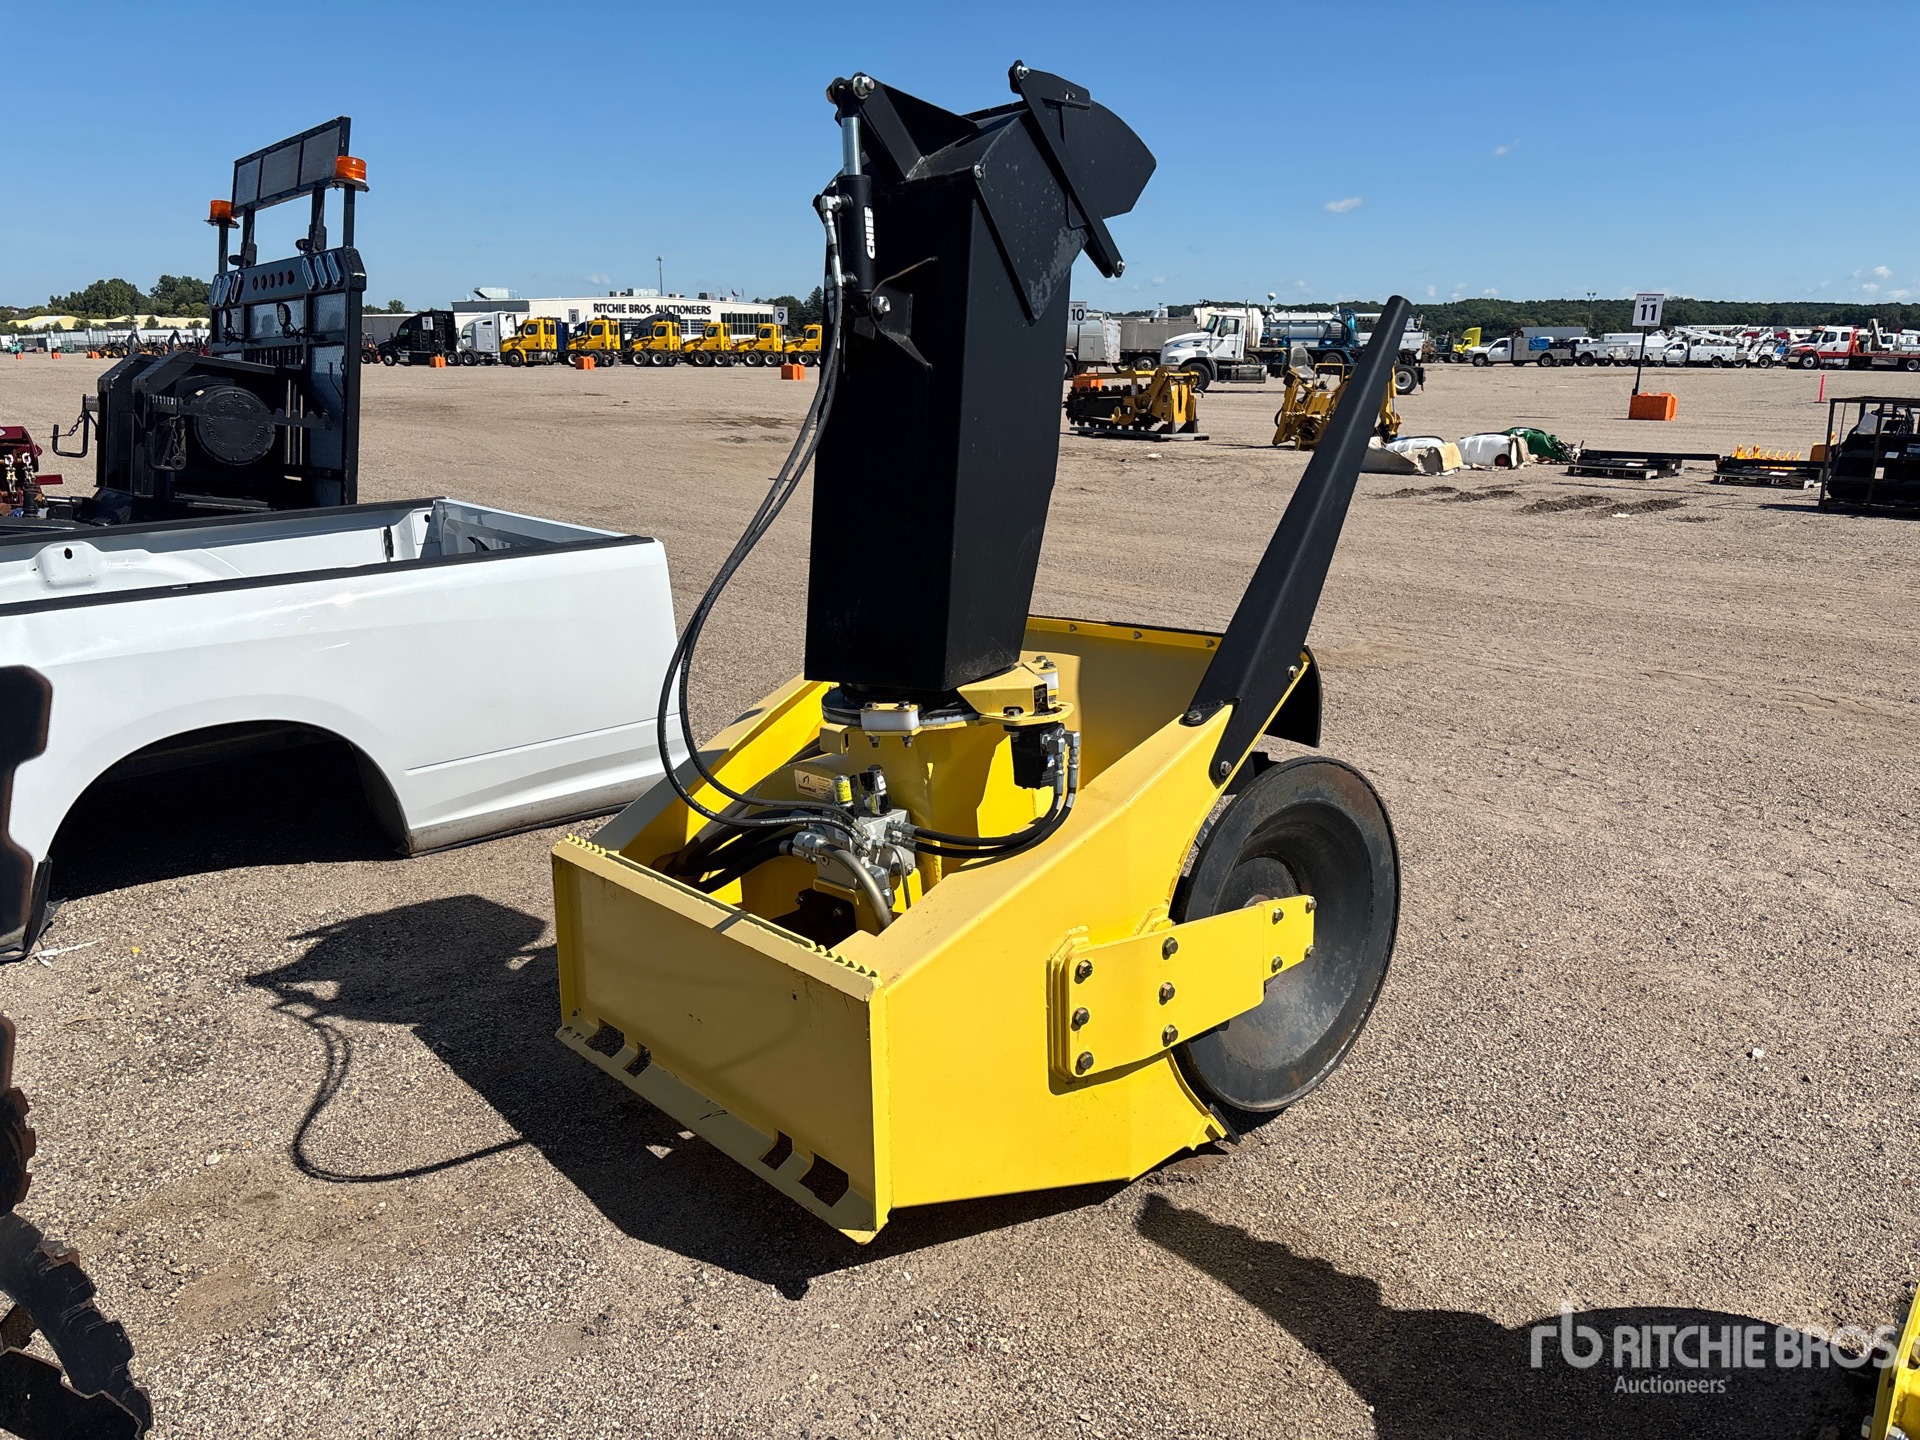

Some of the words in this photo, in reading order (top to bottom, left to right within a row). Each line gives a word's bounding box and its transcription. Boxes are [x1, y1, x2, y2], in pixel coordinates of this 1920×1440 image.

[864, 206, 875, 259] CHIEF
[593, 303, 626, 313] RITCHIE
[629, 304, 653, 314] BROS.
[655, 305, 711, 315] AUCTIONEERS
[1071, 308, 1084, 321] 10
[1641, 304, 1657, 321] 11
[571, 313, 577, 322] 8
[777, 311, 784, 322] 9
